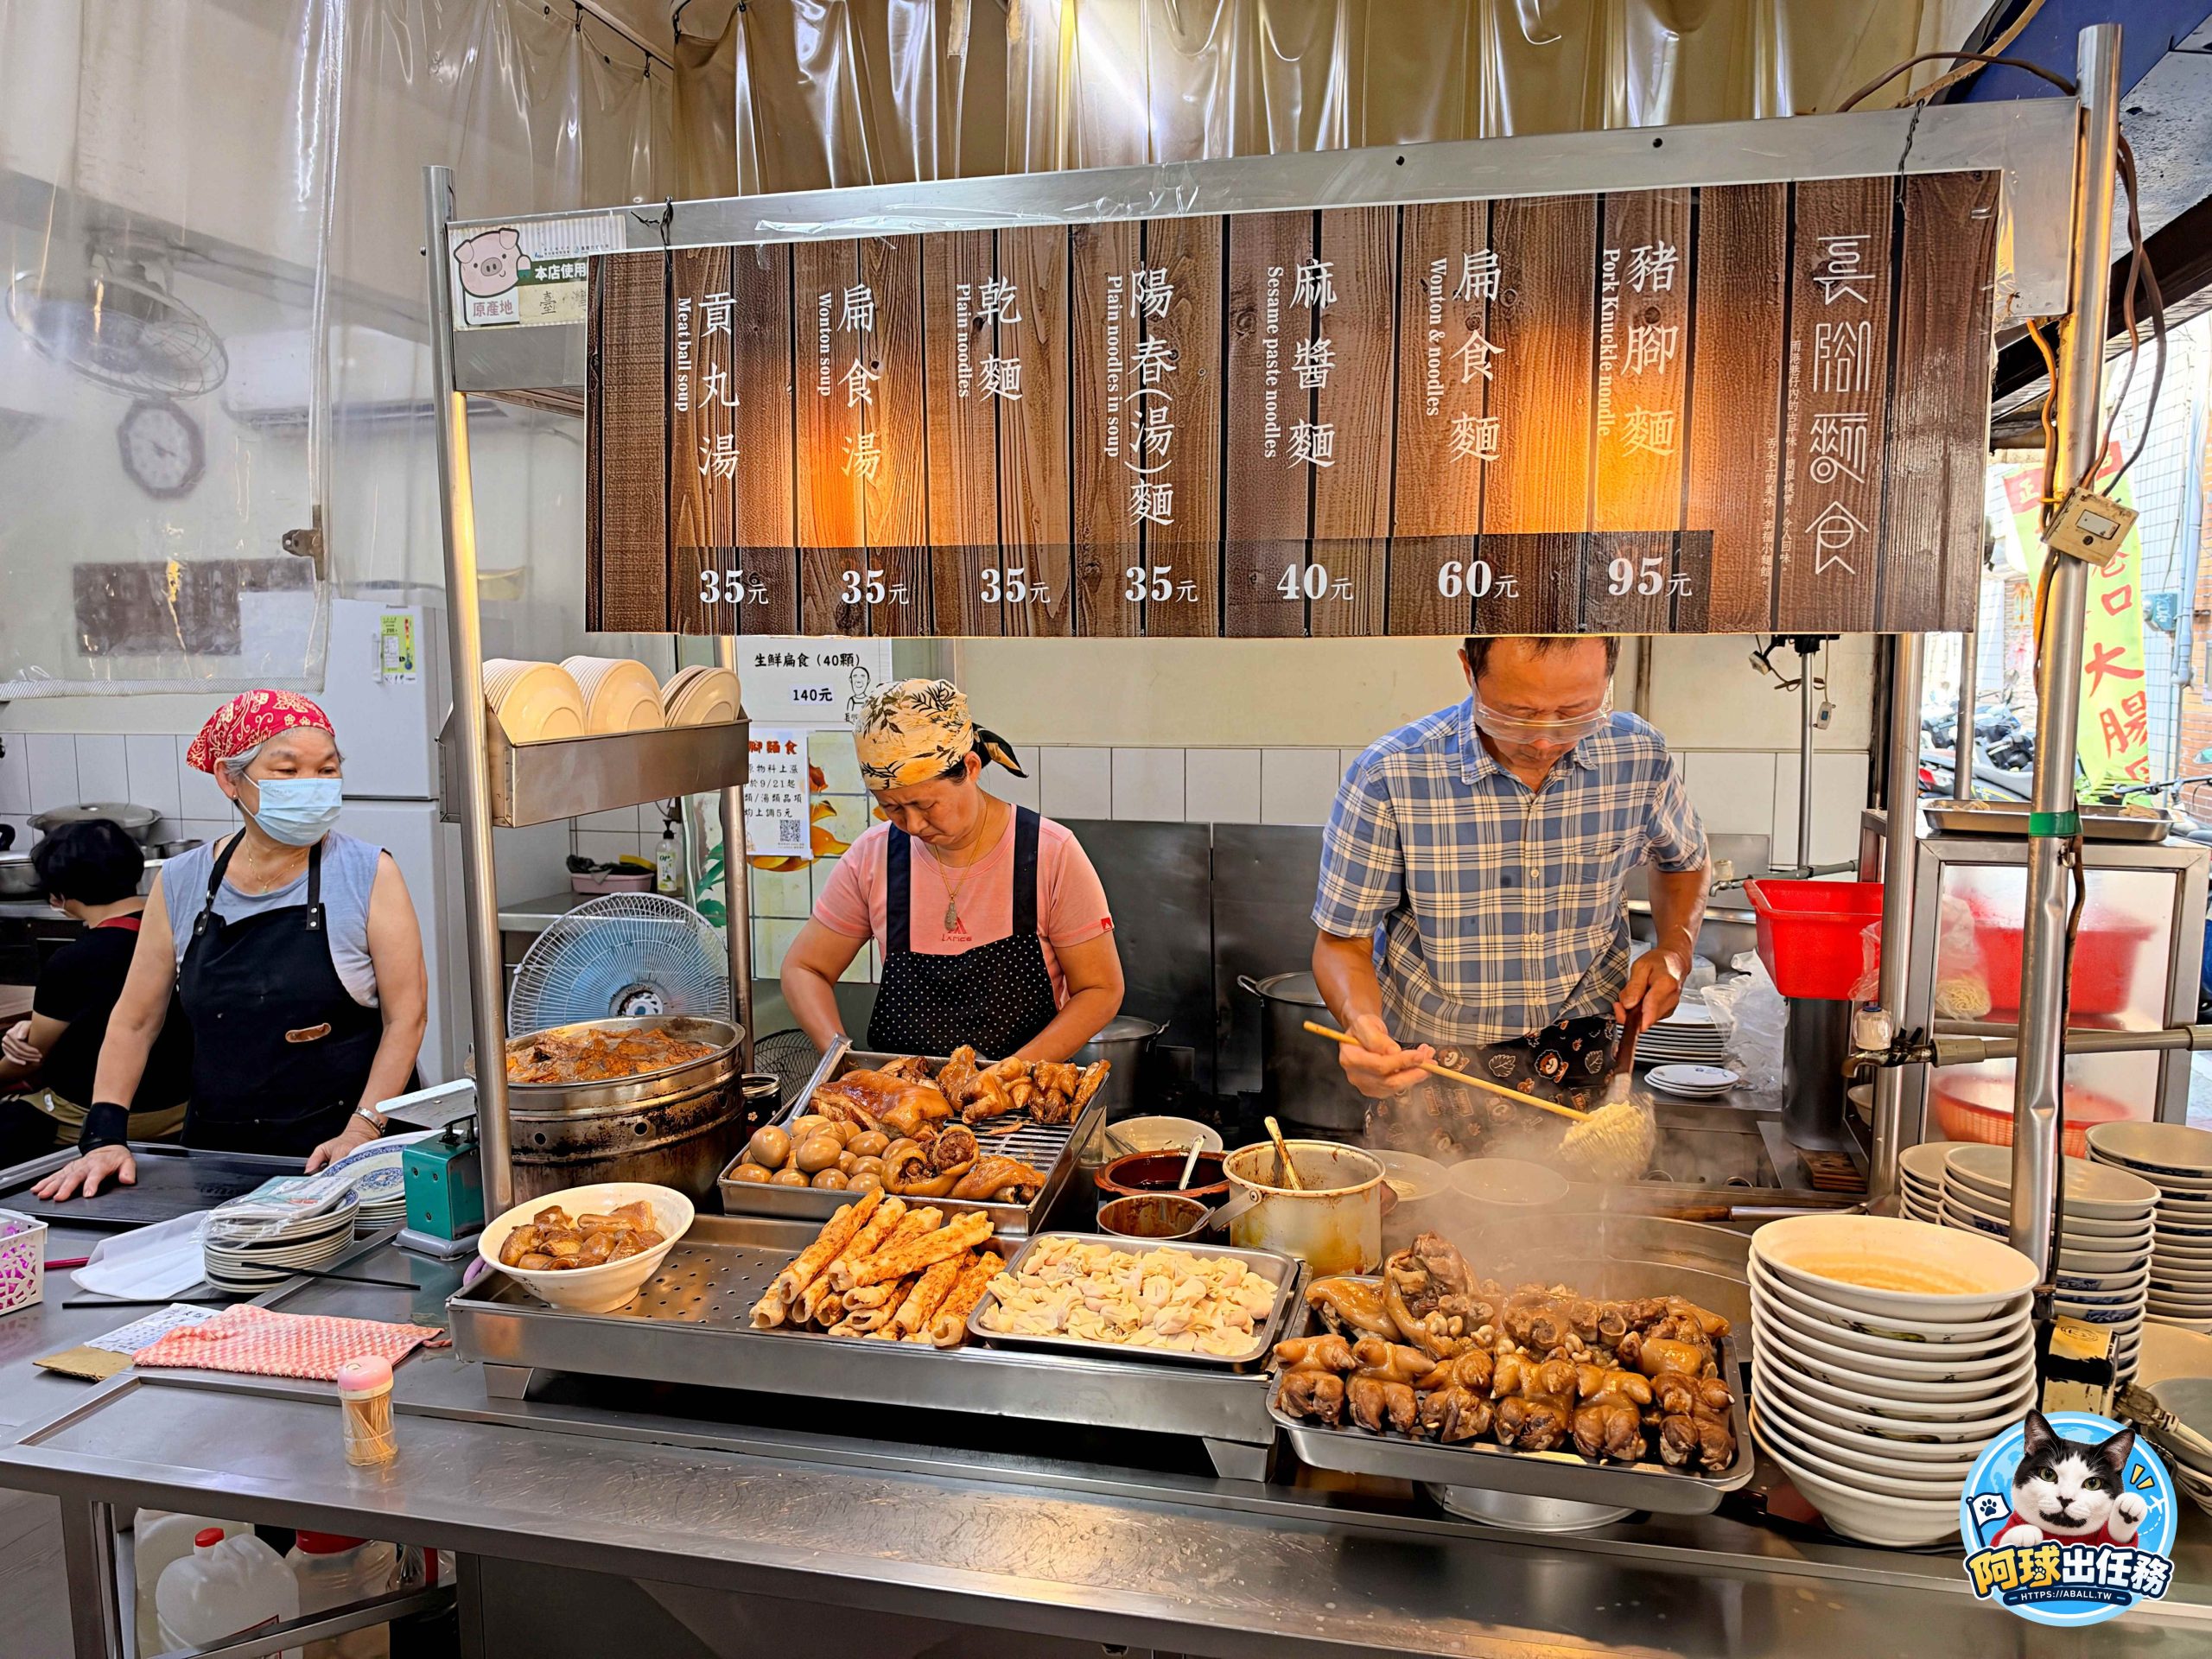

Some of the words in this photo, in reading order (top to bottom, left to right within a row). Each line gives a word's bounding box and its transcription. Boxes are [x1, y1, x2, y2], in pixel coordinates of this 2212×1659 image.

[534, 262, 587, 282] 本店使用
[1429, 257, 1447, 325] Wonton
[1602, 248, 1621, 293] Pork
[473, 300, 514, 317] 原產地
[677, 296, 692, 338] Meat
[957, 283, 972, 328] Plain
[1108, 276, 1123, 321] Plain
[1267, 266, 1284, 334] Sesame
[818, 292, 832, 353] Wonton
[977, 276, 1023, 402] 乾麵
[1428, 329, 1446, 344] &
[1599, 296, 1618, 372] Knuckle
[677, 341, 692, 371] ball
[957, 332, 973, 397] noodles
[1108, 325, 1123, 392] noodles
[1262, 338, 1281, 386] paste
[1286, 258, 1338, 468] 麻醬麵
[1447, 247, 1505, 463] 扁食麵
[1620, 239, 1680, 458] 豬腳麵
[675, 374, 689, 411] soup
[698, 292, 741, 480] 貢丸湯
[817, 358, 831, 397] soup
[836, 283, 881, 480] 扁食湯
[1427, 347, 1445, 416] noodles
[1108, 396, 1123, 413] in
[1264, 390, 1281, 458] noodles
[1599, 373, 1617, 436] noodle
[1104, 416, 1119, 457] soup
[699, 569, 769, 605] 35元
[841, 569, 910, 605] 35元
[980, 567, 1051, 604] 35元
[1124, 565, 1198, 603] 35元
[1276, 563, 1354, 601] 40元
[1437, 559, 1519, 599] 60元
[1607, 557, 1693, 598] 95元
[792, 688, 833, 702] 140元
